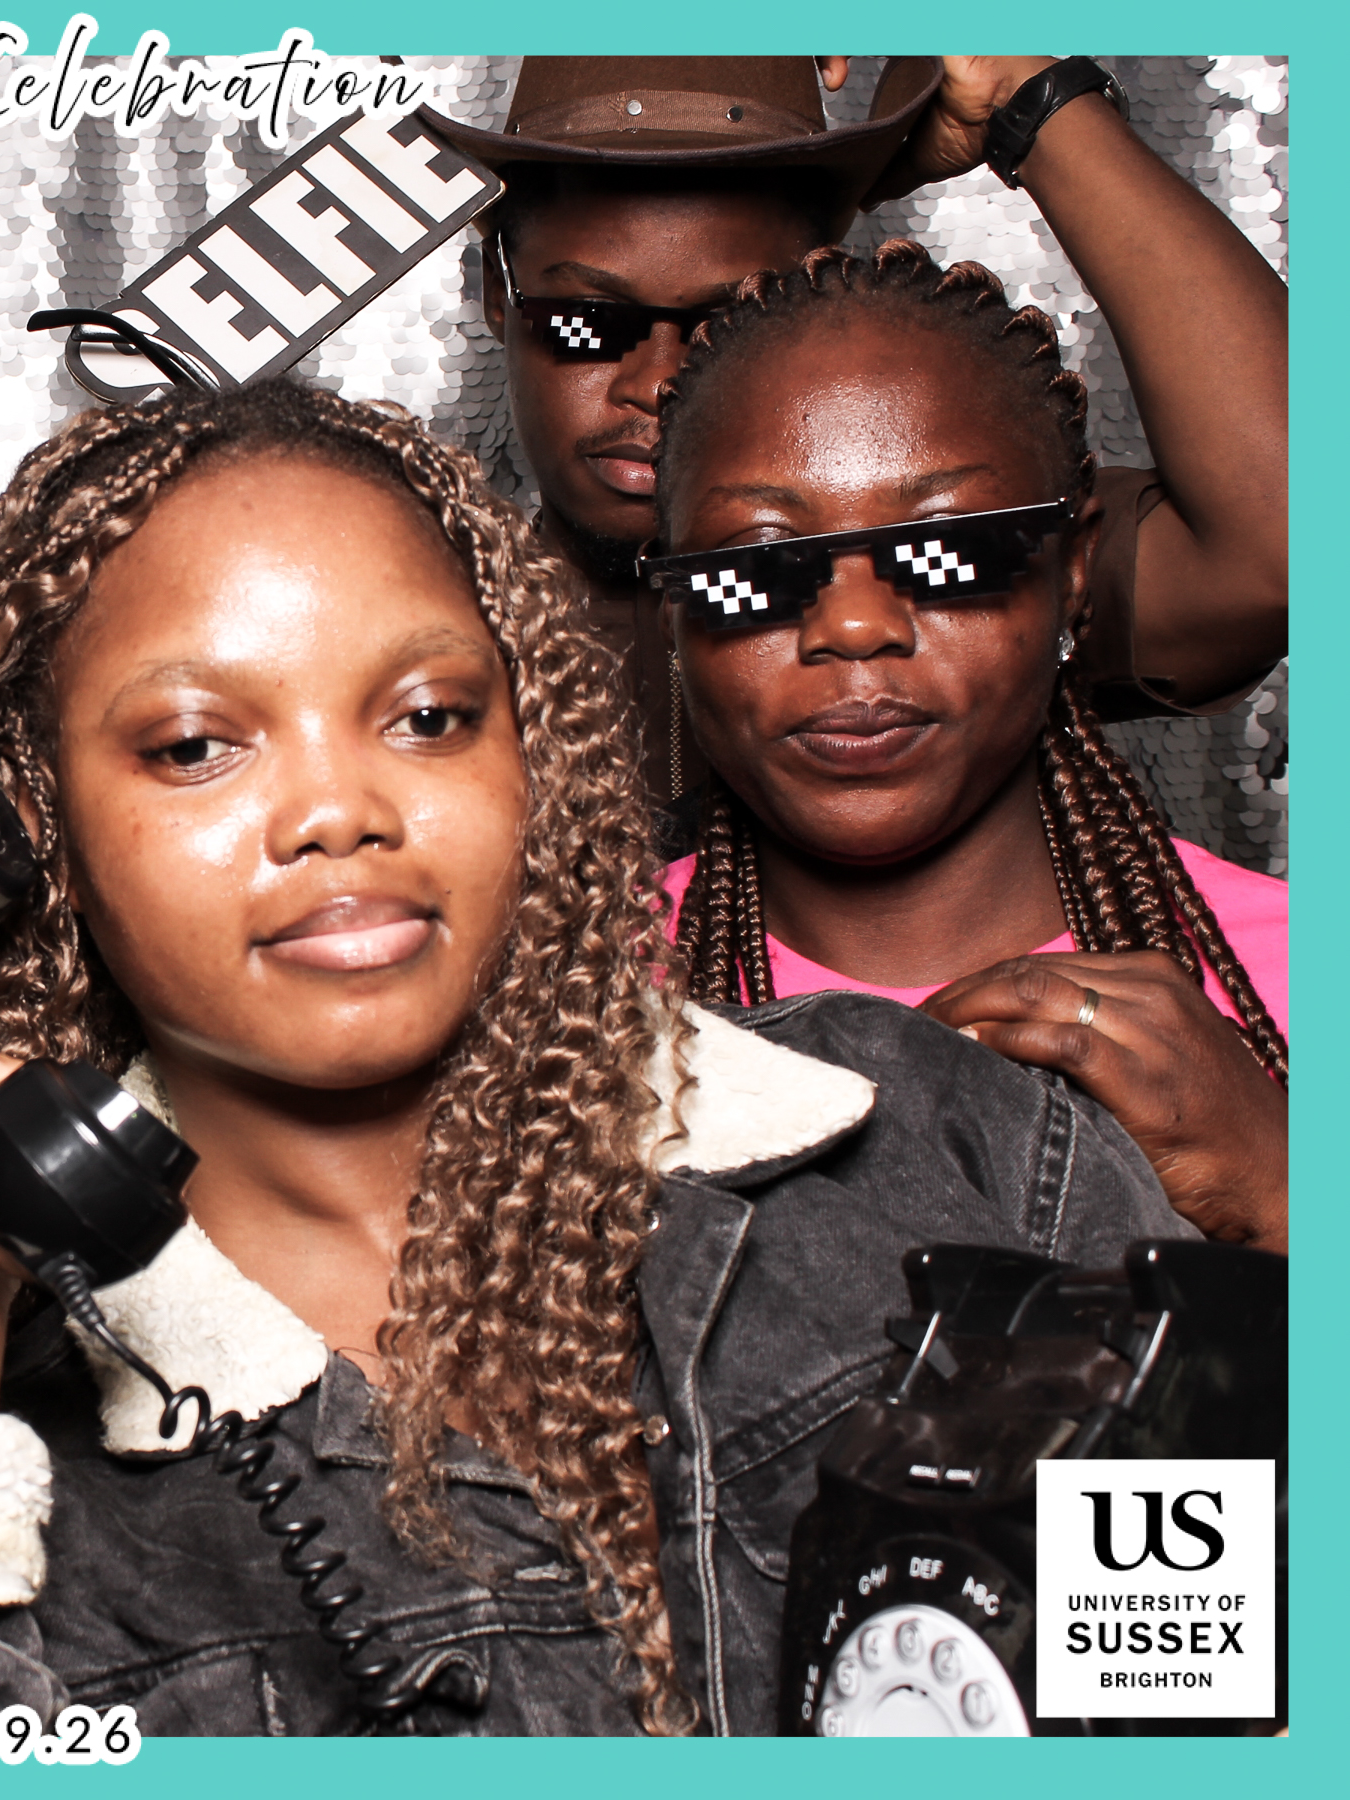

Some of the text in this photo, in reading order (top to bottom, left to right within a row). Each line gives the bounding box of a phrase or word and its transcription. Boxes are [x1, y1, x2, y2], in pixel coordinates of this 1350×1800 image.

[858, 1564, 888, 1596] GHI
[909, 1556, 944, 1580] DEF
[961, 1576, 1000, 1617] ABC
